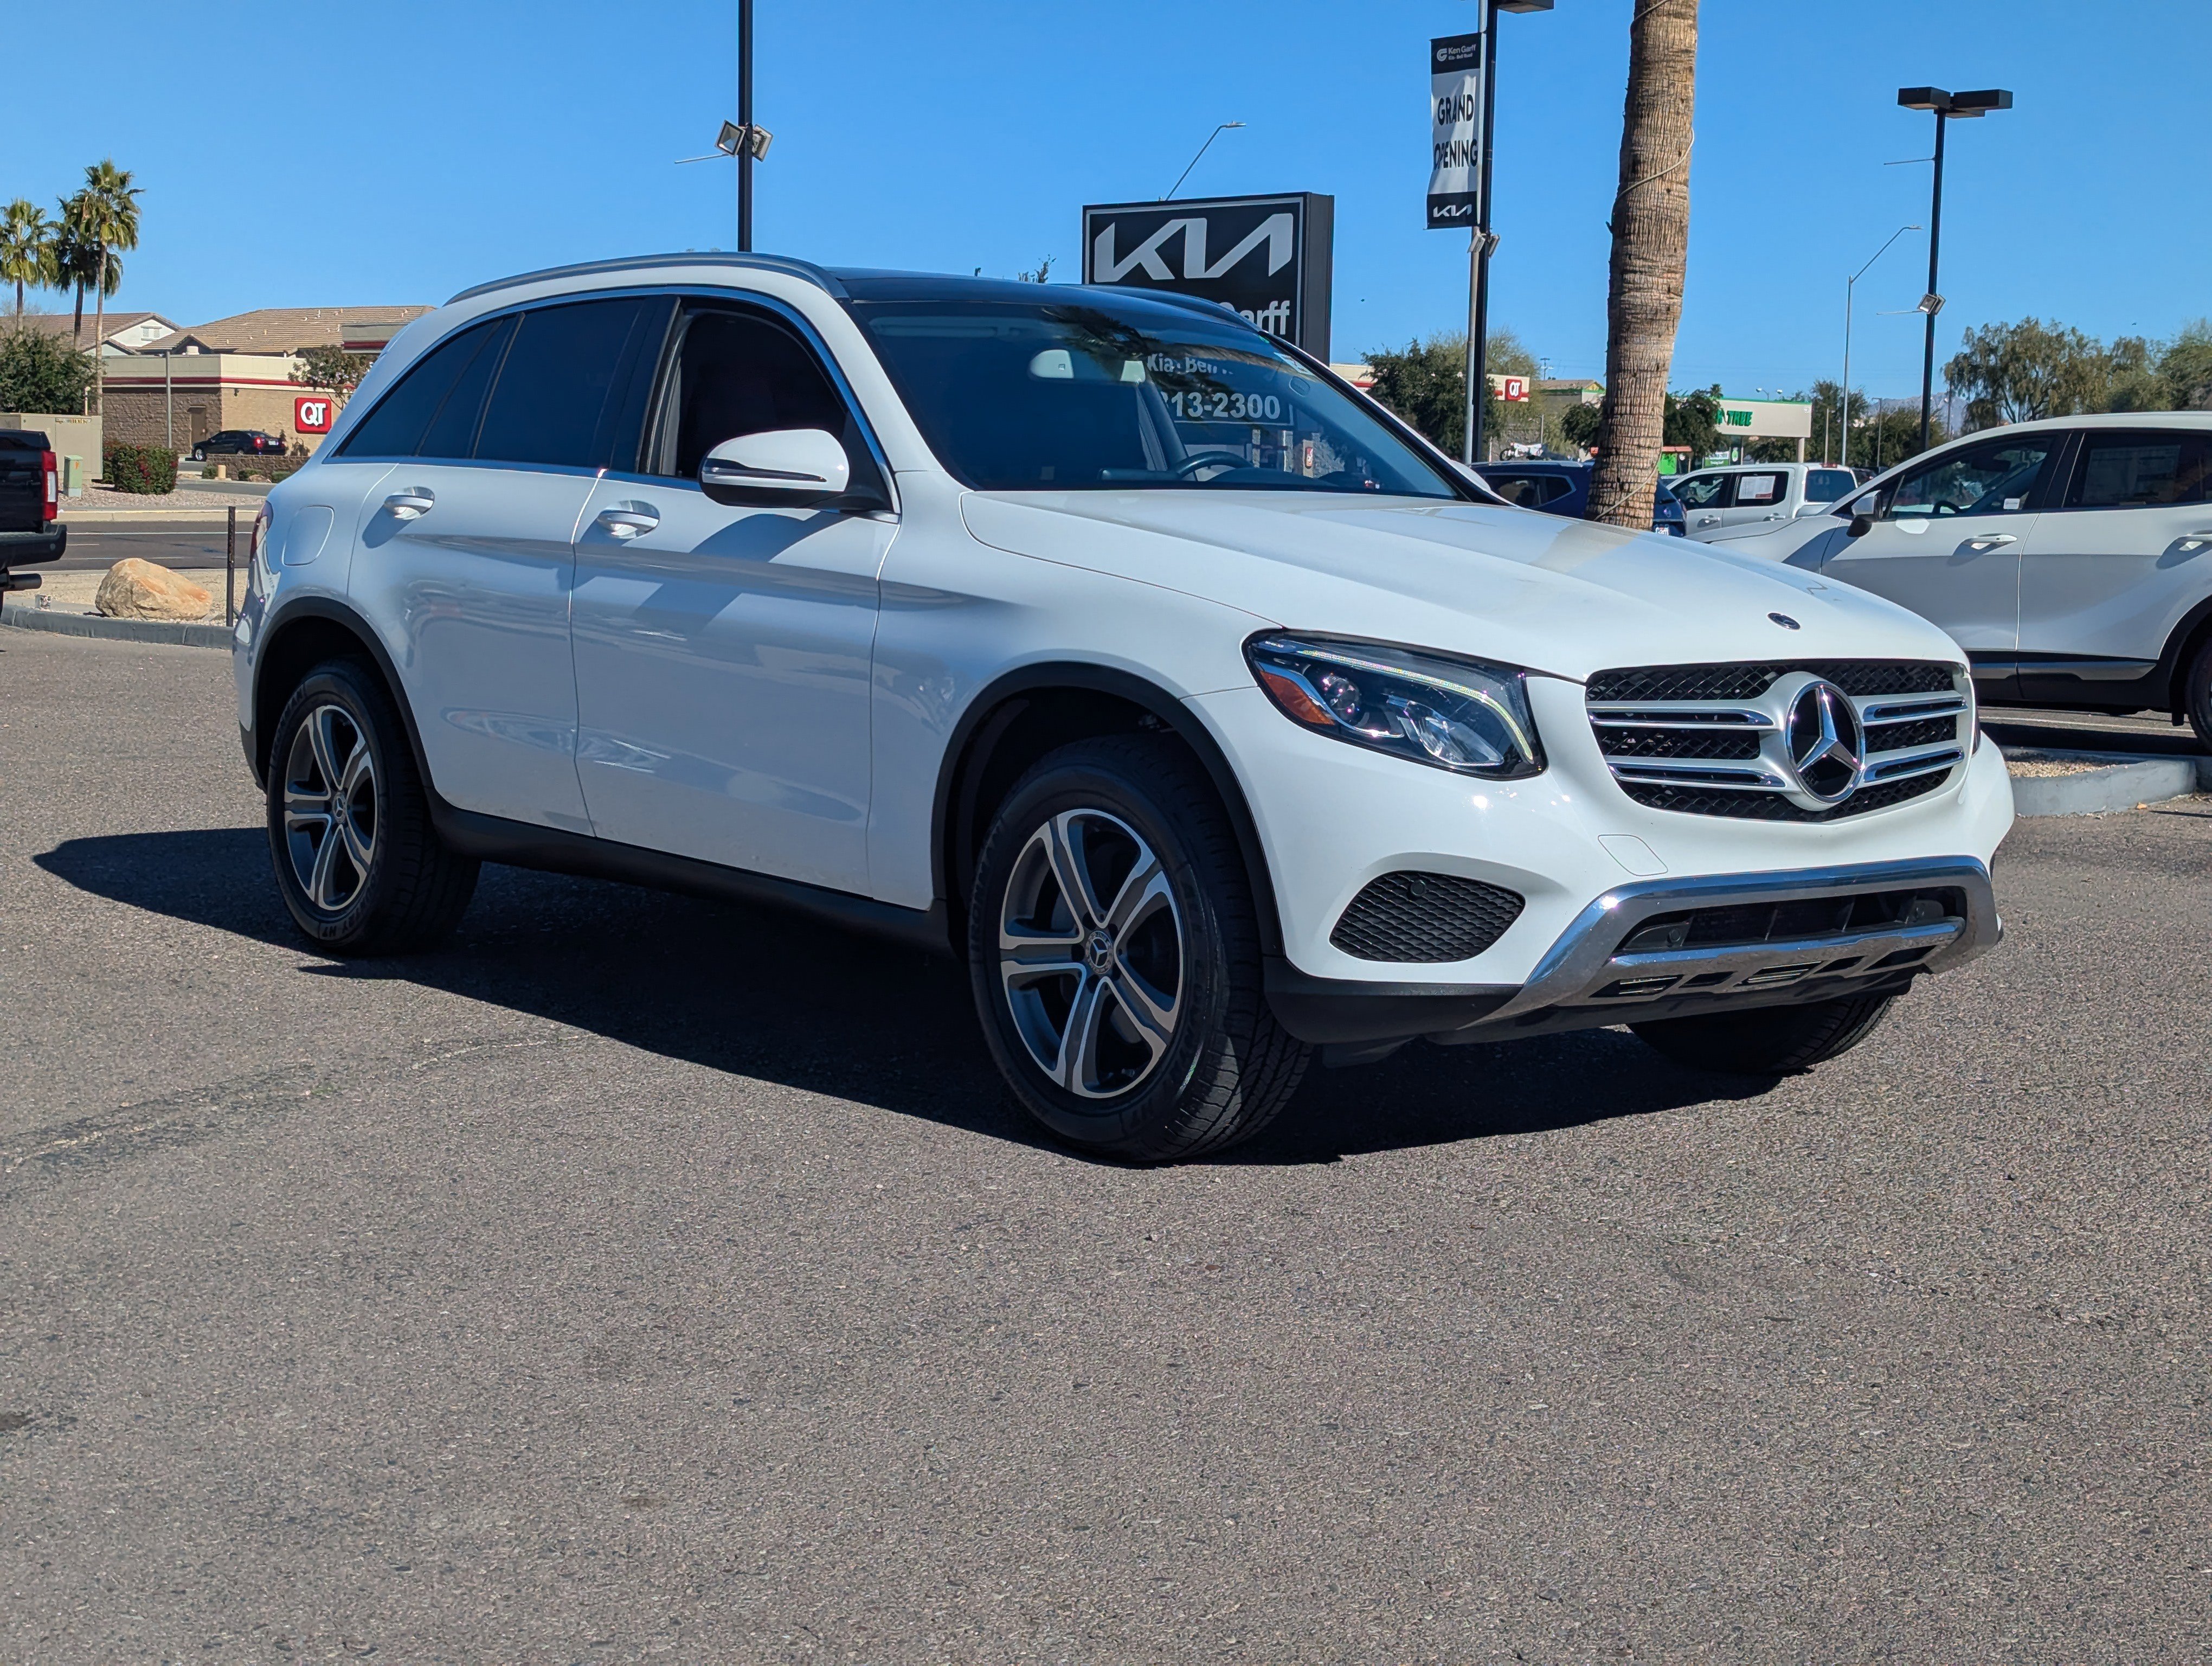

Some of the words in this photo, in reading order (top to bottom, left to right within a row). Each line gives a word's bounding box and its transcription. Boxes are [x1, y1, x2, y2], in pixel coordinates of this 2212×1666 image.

[1438, 94, 1474, 125] GRAND
[1434, 139, 1478, 170] OPENING
[1433, 204, 1472, 217] KIA
[1094, 213, 1293, 282] KIA
[1509, 381, 1521, 396] QT
[300, 402, 326, 426] QT
[1161, 391, 1280, 419] 13-2300
[1726, 410, 1753, 427] TREE
